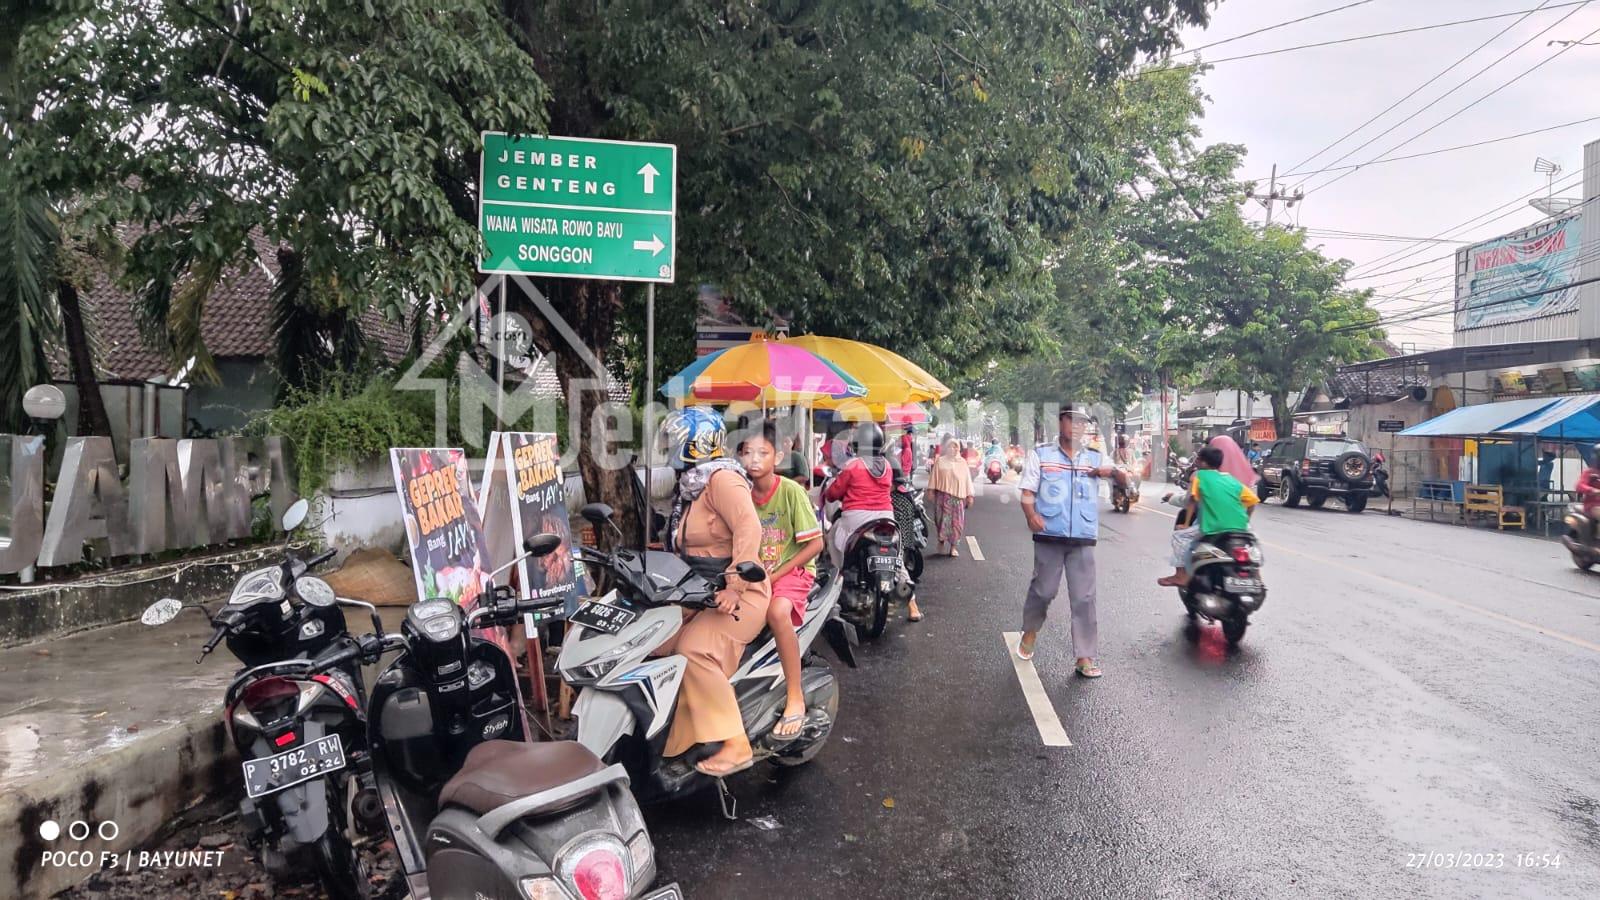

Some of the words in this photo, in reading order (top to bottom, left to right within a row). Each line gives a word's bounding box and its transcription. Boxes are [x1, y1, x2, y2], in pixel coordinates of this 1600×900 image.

[498, 150, 597, 169] JEMBER
[497, 175, 616, 195] GENTENG
[486, 215, 517, 233] WANA
[521, 217, 559, 236] WISATA
[562, 220, 593, 237] ROWO
[597, 222, 623, 239] BAYU
[518, 244, 592, 264] SONGGON
[515, 439, 554, 470] GEPREK
[409, 463, 459, 508] GEPREK
[519, 461, 557, 491] BAKAR
[417, 491, 465, 536] BAKAR
[427, 533, 447, 551] Bang
[483, 719, 509, 735] Stylish
[246, 764, 256, 779] P
[270, 749, 308, 773] 3782
[318, 737, 339, 755] RW
